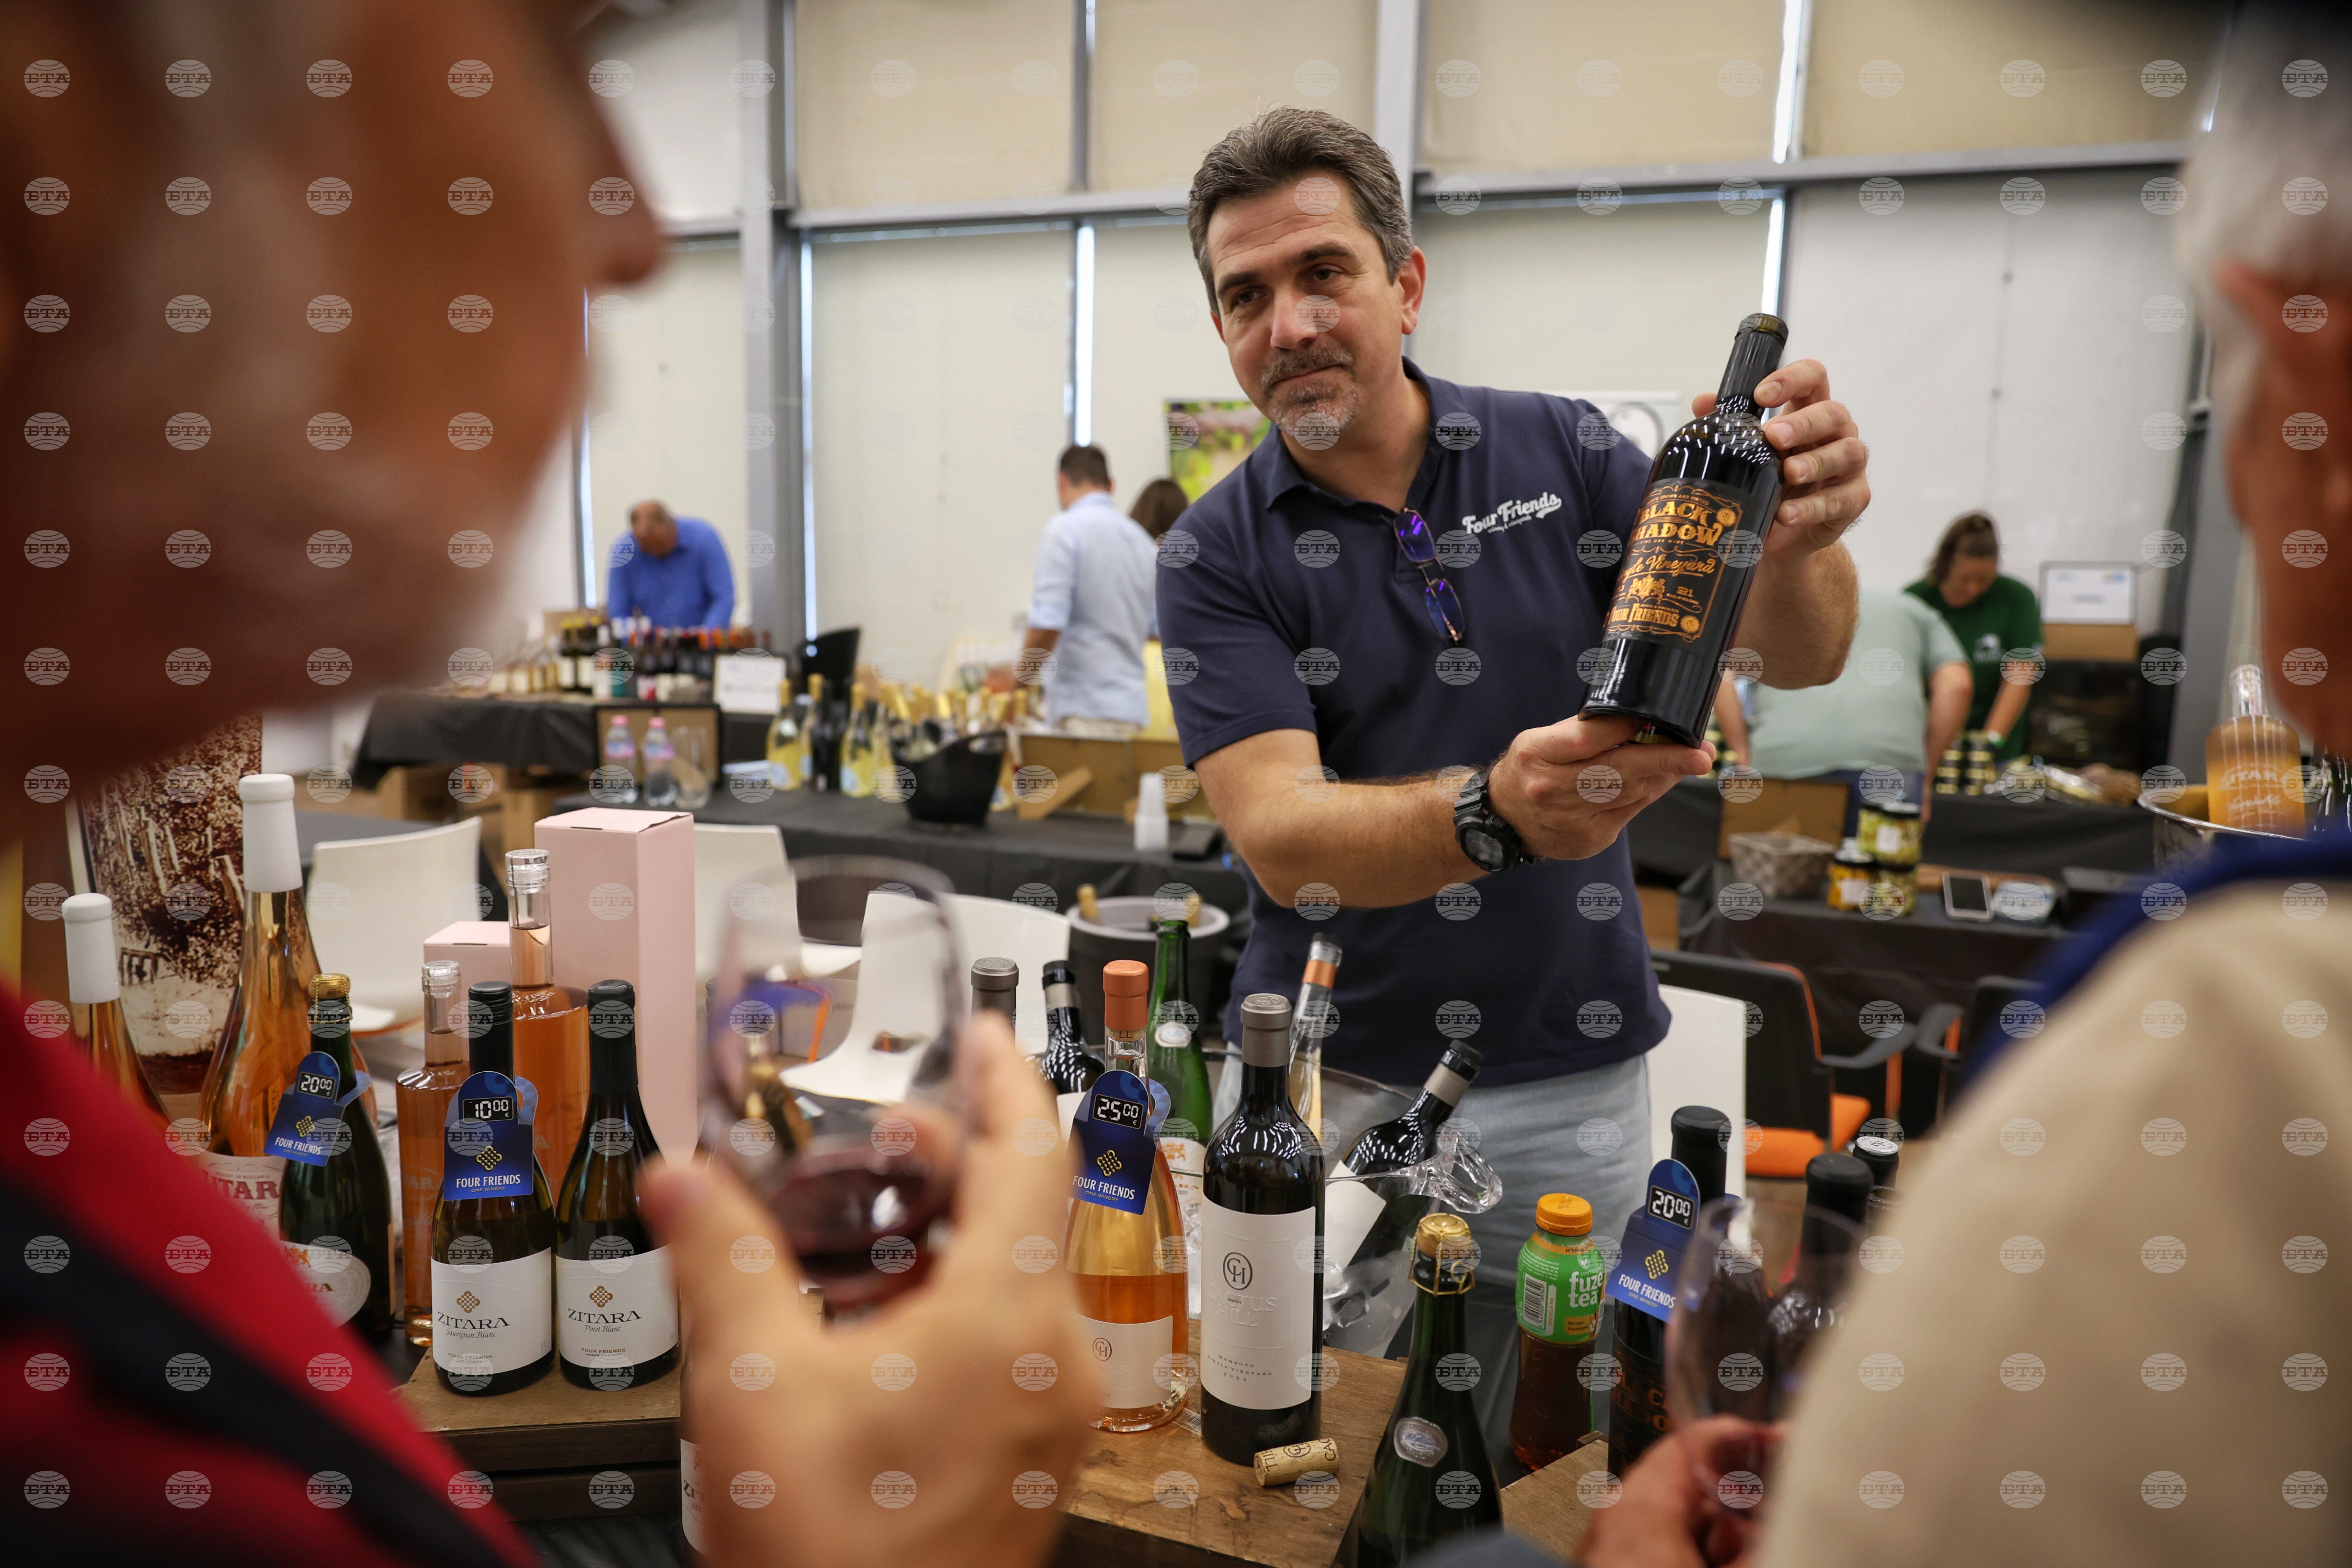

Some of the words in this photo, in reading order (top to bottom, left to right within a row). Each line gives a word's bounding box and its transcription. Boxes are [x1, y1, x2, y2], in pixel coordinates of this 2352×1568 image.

[1462, 513, 1498, 534] Four
[1497, 491, 1562, 522] Friends
[1639, 501, 1713, 527] BLACK
[1646, 554, 1716, 577] Vineyard
[1628, 603, 1680, 627] FRIENDS
[274, 1137, 294, 1149] FOUR
[293, 1141, 323, 1155] FRIENDS
[456, 1177, 481, 1188] FOUR
[483, 1174, 521, 1186] FRIENDS
[1072, 1176, 1096, 1191] FOUR
[1098, 1181, 1135, 1200] FRIENDS
[1098, 1193, 1119, 1202] WINERY
[1569, 1271, 1603, 1293] fuze
[1568, 1290, 1597, 1308] tea
[1618, 1274, 1642, 1294] FOUR
[1640, 1284, 1676, 1309] FRIENDS
[438, 1311, 511, 1329] ZITARA
[568, 1308, 642, 1324] ZITARA
[446, 1328, 475, 1340] Sauvignon
[476, 1330, 496, 1339] Blanc
[1231, 1367, 1272, 1376] VINEYARD
